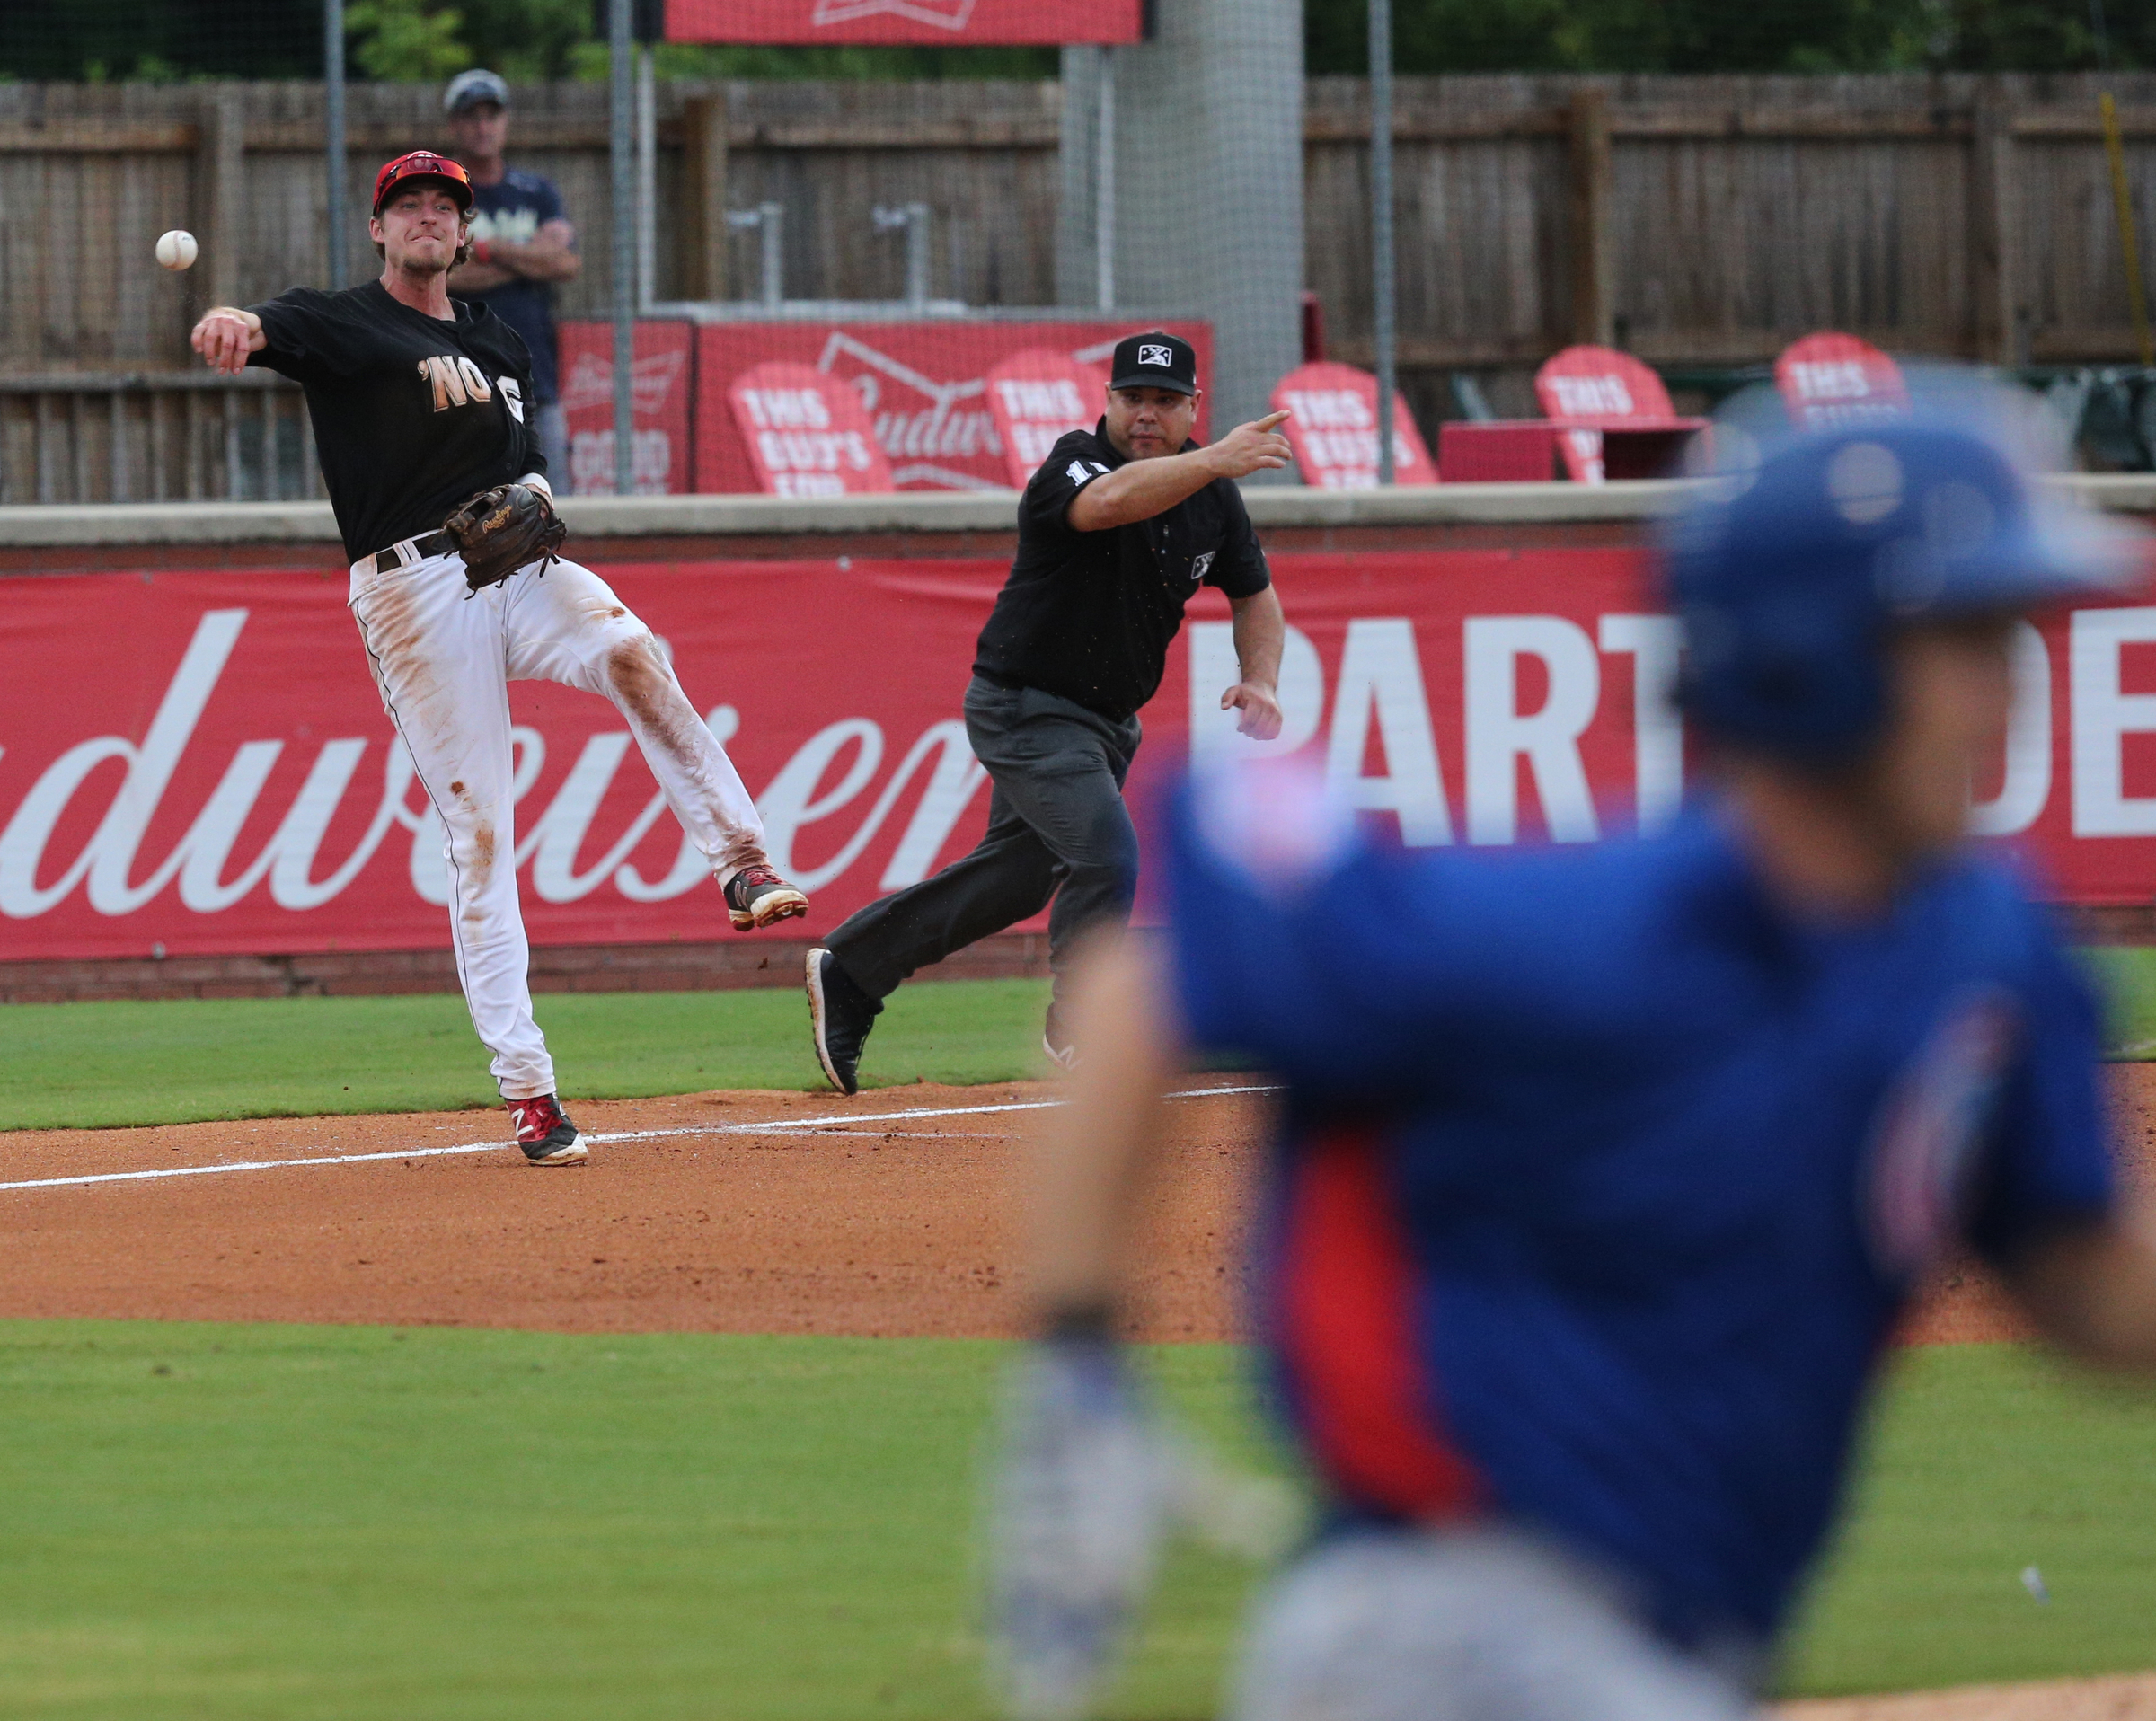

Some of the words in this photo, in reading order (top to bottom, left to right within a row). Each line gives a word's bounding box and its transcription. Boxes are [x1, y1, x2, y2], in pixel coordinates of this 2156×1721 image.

[742, 388, 830, 429] THIS
[997, 380, 1084, 420] THIS
[1283, 389, 1373, 428] THIS
[1547, 375, 1634, 415] THIS
[1188, 614, 1689, 849] PART
